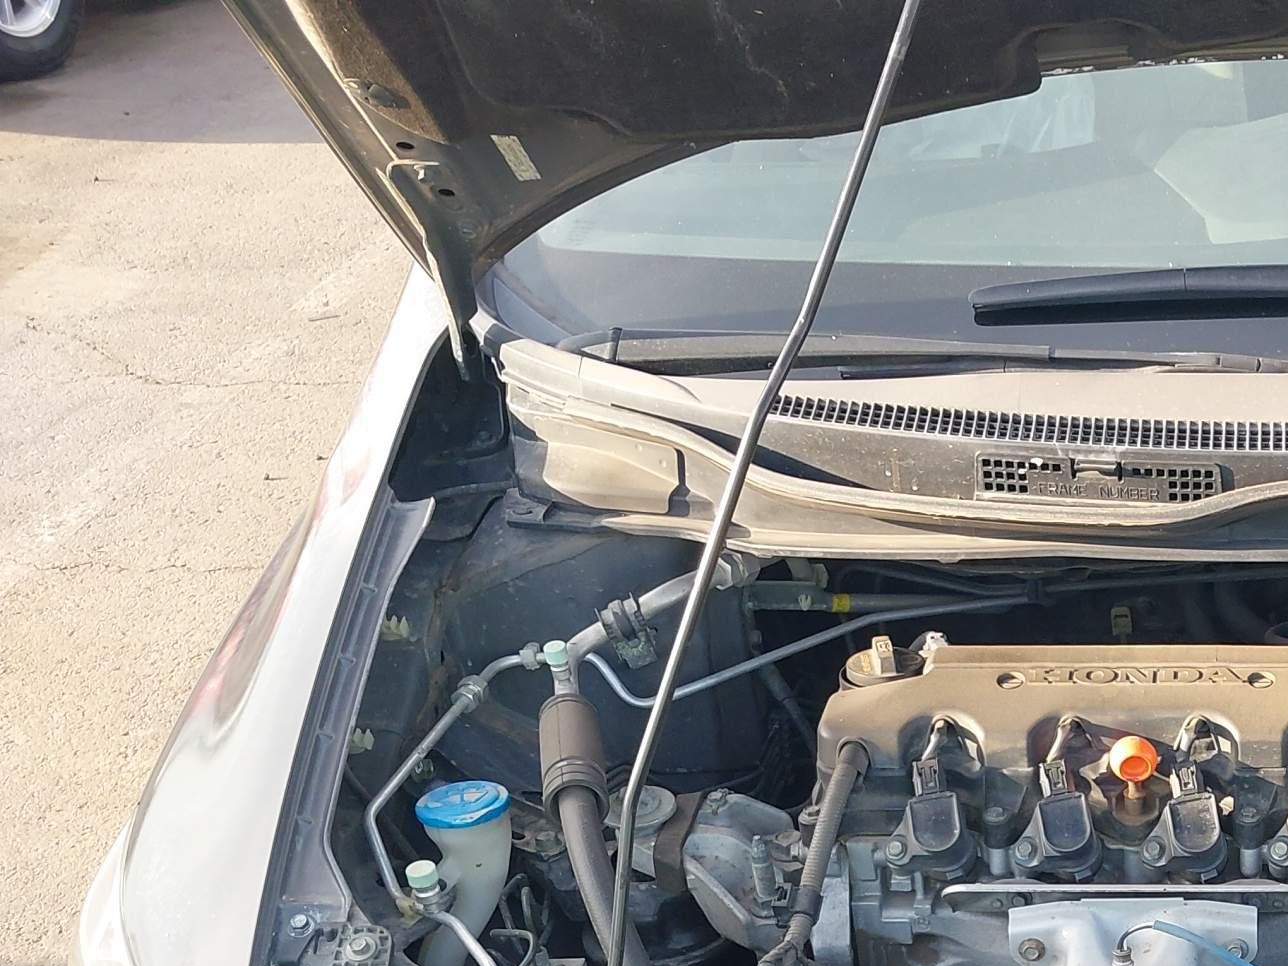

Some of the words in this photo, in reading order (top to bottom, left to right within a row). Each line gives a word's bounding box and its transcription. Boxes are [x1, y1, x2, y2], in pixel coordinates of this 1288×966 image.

[1037, 482, 1088, 496] FRAME
[1099, 484, 1160, 500] NUMBER
[1028, 666, 1249, 684] HONDA
